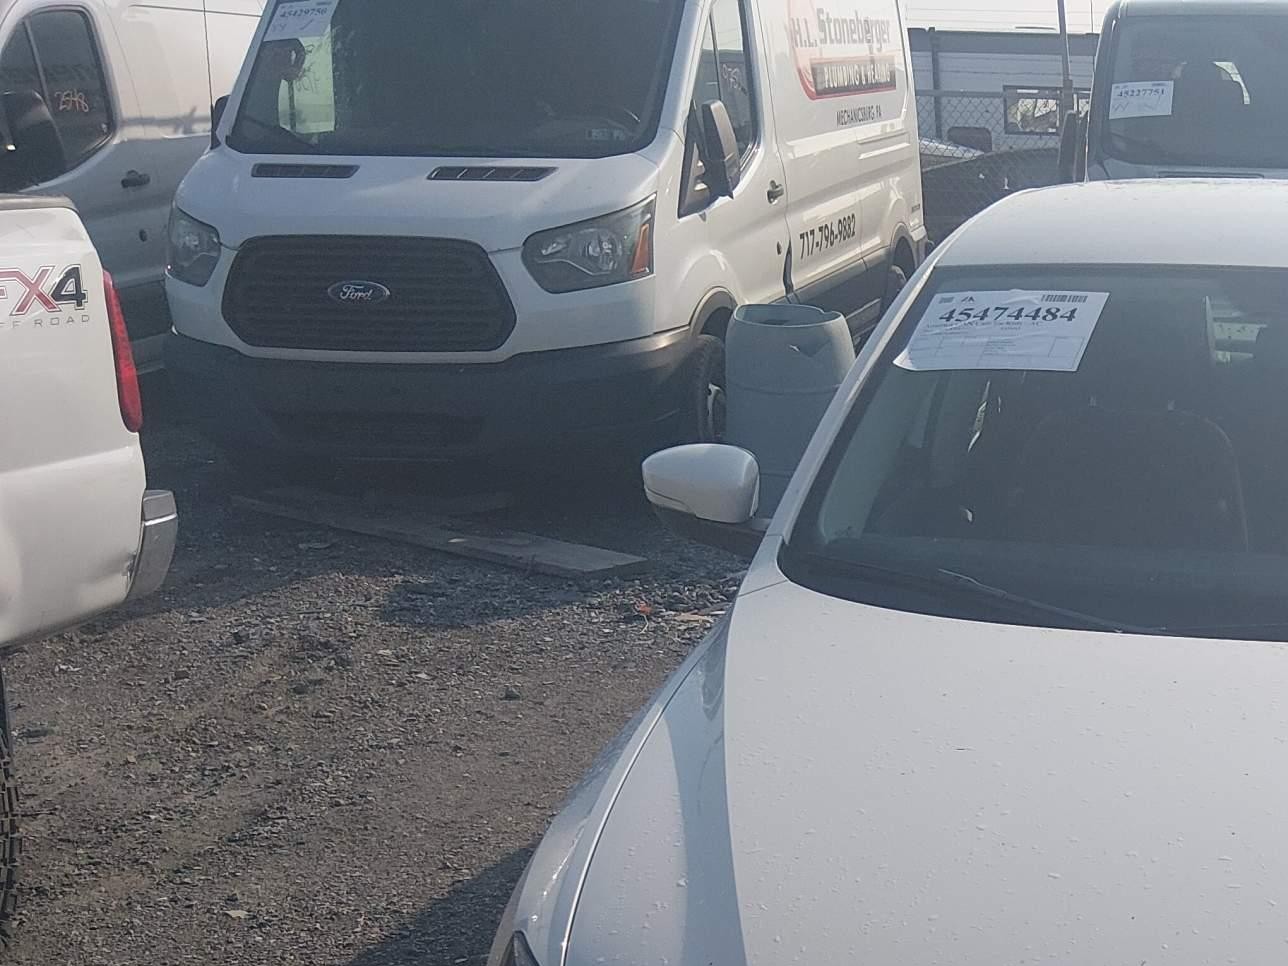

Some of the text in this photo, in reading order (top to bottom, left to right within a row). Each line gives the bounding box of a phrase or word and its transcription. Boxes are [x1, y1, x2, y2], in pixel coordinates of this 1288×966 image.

[816, 7, 891, 52] Stoneberger
[799, 212, 856, 260] 717-796-9882
[340, 284, 373, 300] Ford
[33, 314, 91, 328] ROAD
[939, 306, 1077, 322] 45474484
